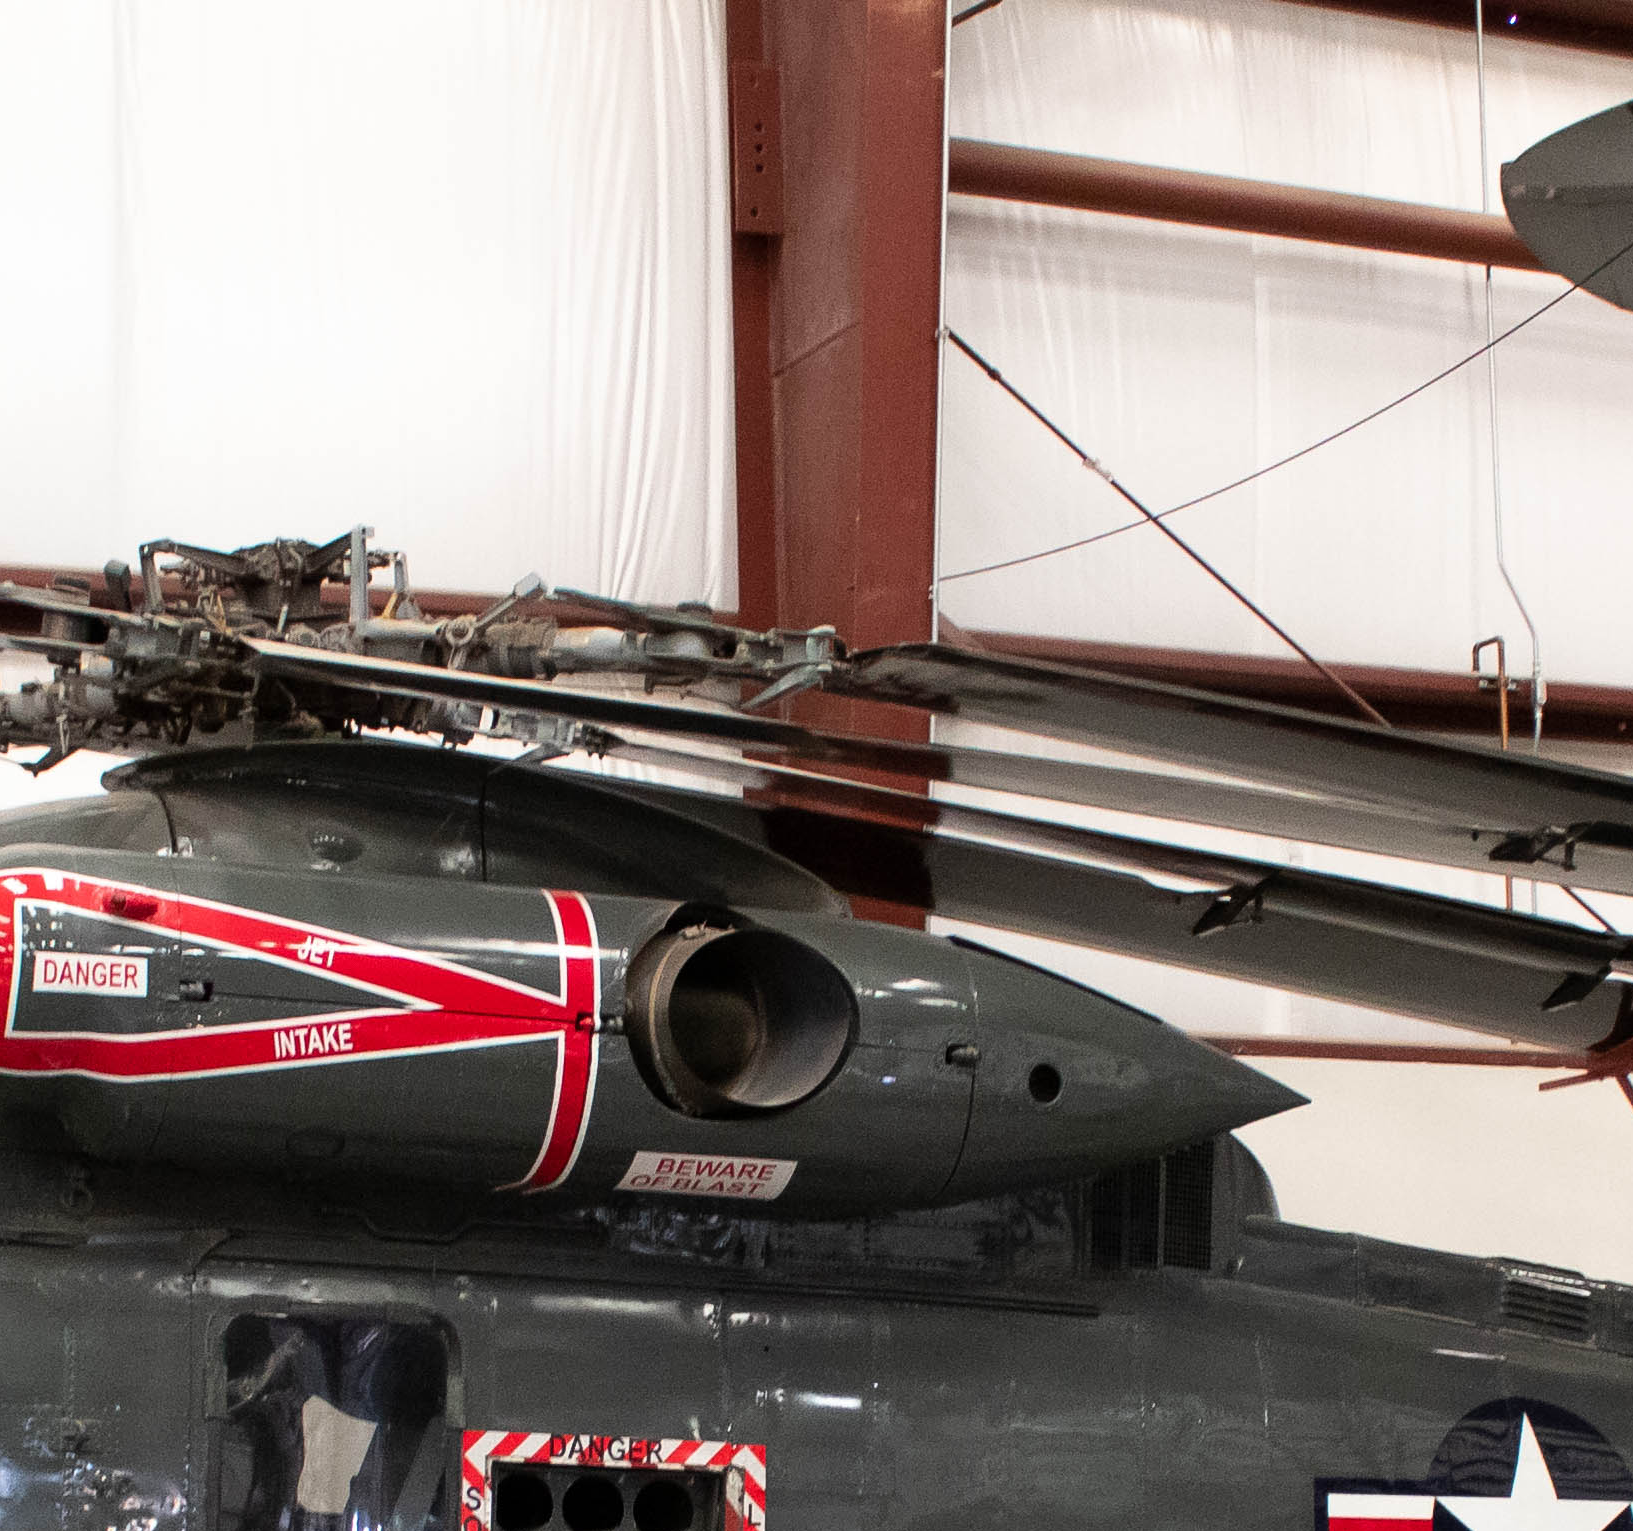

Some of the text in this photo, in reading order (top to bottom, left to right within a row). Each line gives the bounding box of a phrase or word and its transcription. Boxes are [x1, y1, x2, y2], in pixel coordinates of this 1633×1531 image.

[297, 935, 341, 968] JET
[43, 959, 138, 989] DANGER
[273, 1022, 354, 1060] INTAKE
[630, 1174, 765, 1195] OF BLAST
[655, 1158, 777, 1181] BEWARE
[549, 1434, 664, 1464] DANGER
